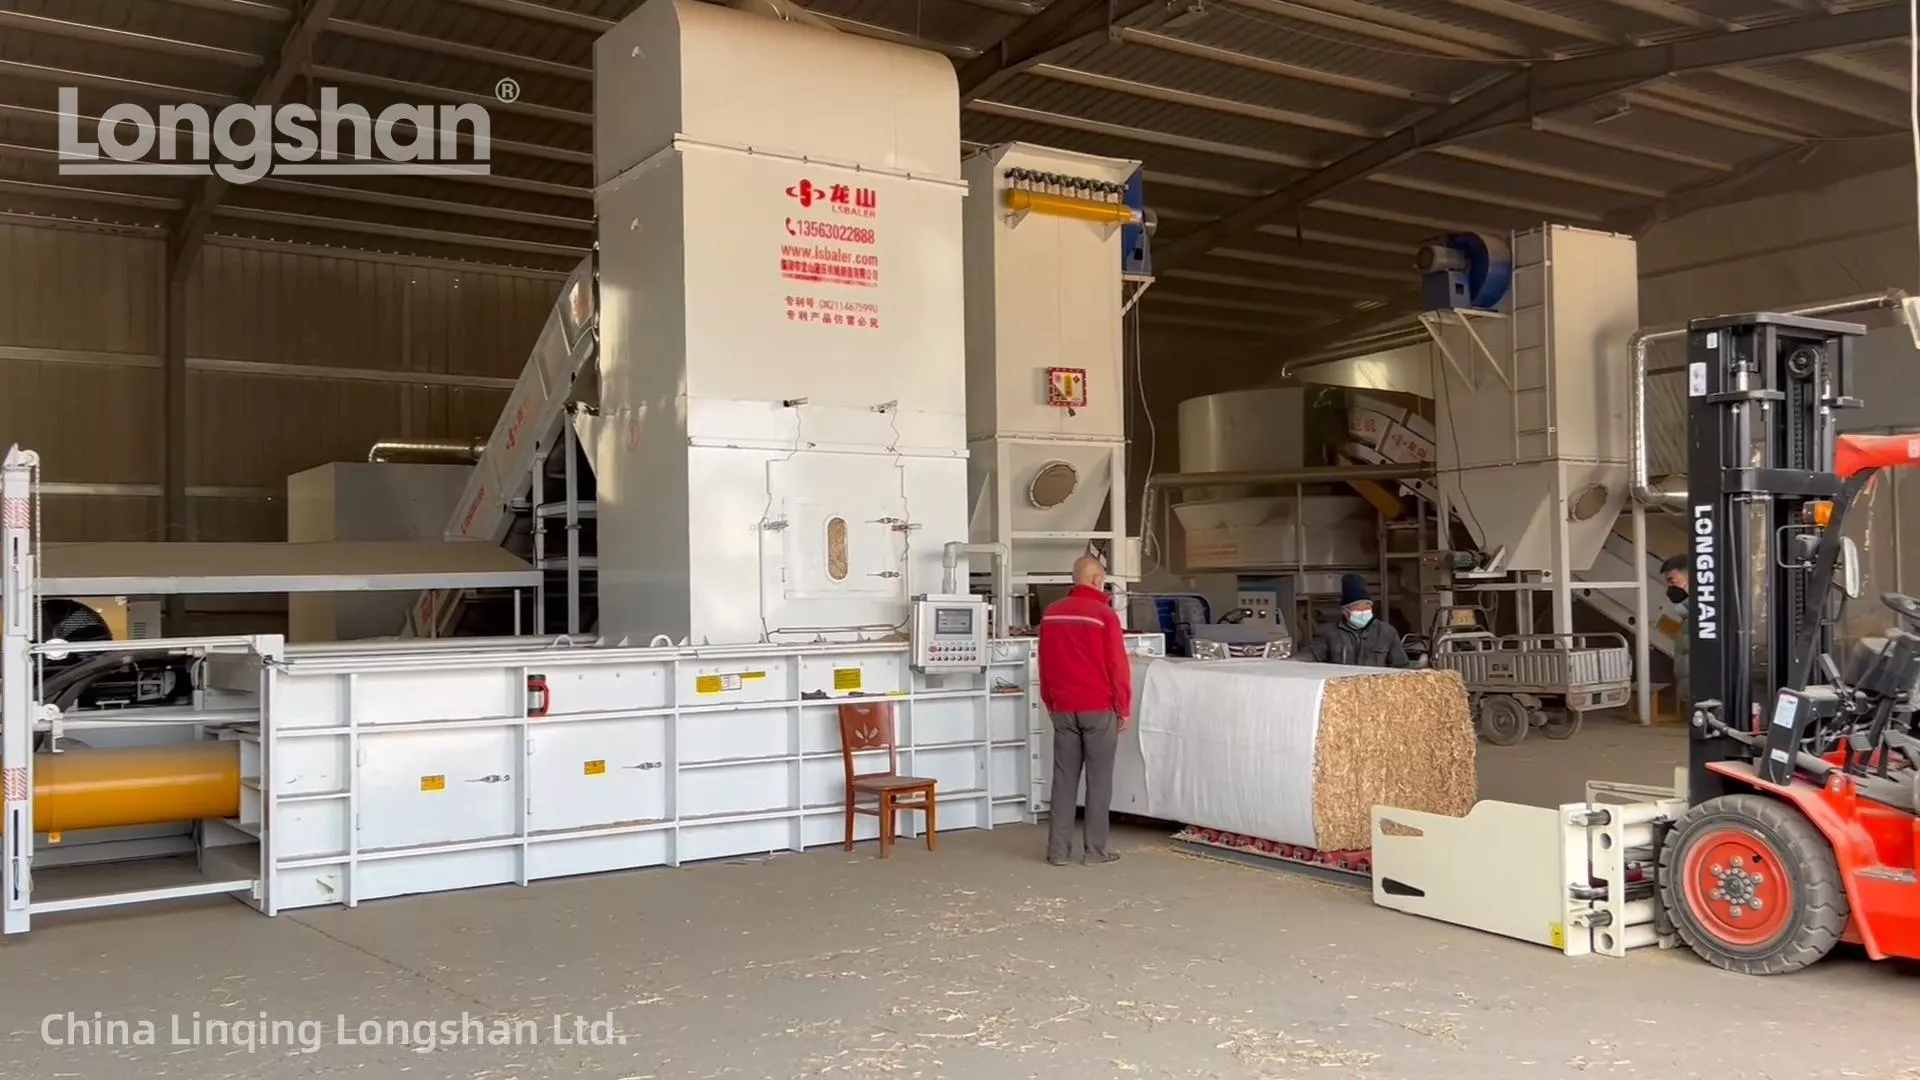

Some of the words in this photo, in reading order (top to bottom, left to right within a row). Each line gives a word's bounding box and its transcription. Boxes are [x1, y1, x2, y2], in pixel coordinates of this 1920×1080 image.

[830, 183, 876, 208] 龙山
[832, 204, 876, 218] LSBALER
[797, 219, 875, 244] 13563022888
[781, 245, 878, 266] www.lsbaler.com
[1694, 505, 1717, 640] LONGSHAN
